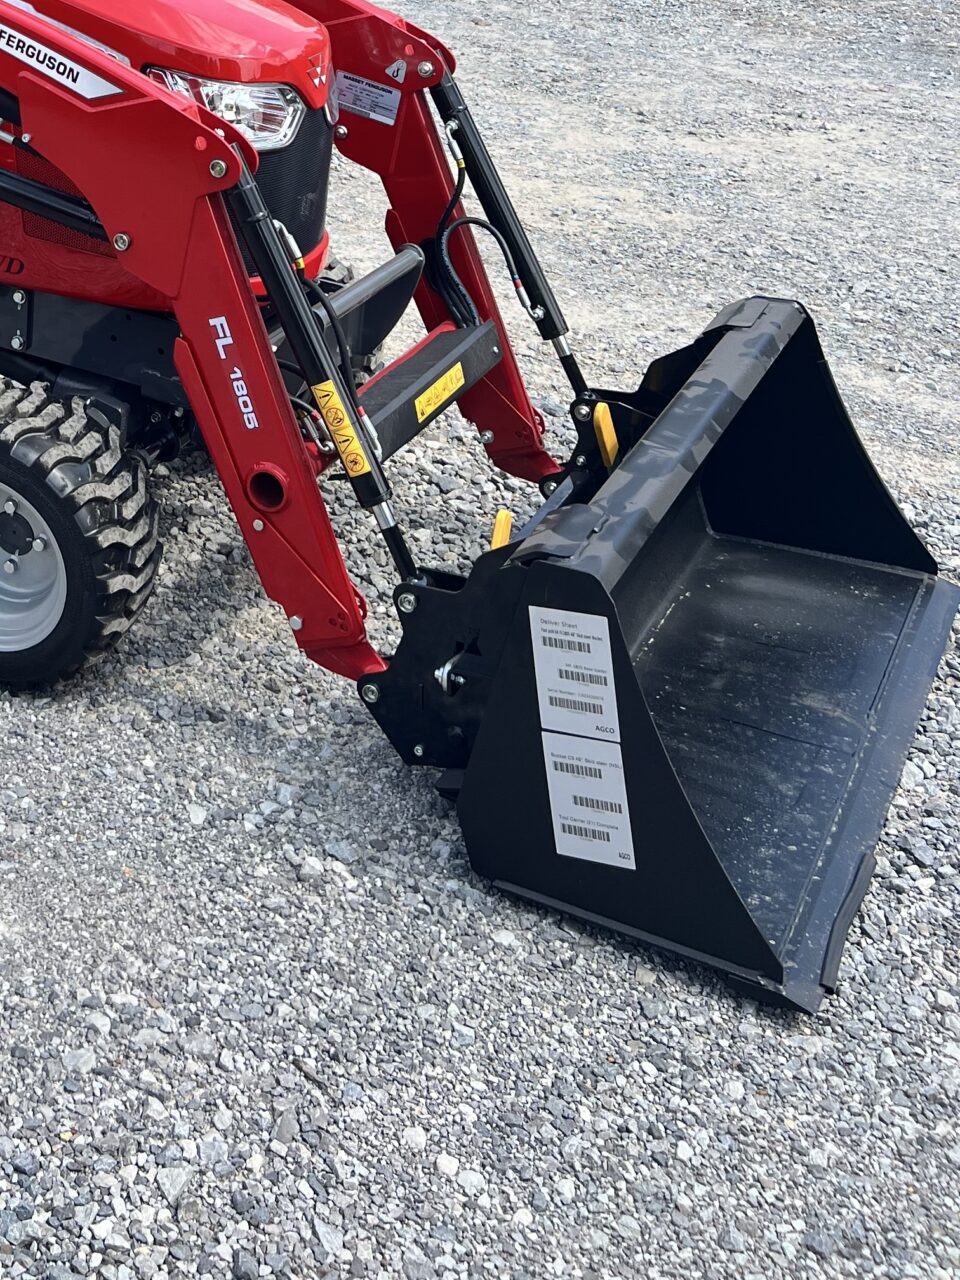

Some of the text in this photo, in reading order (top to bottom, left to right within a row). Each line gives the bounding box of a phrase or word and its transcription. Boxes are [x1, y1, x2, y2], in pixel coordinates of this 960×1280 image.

[208, 315, 259, 429] FL 1805
[595, 725, 615, 734] AGCO
